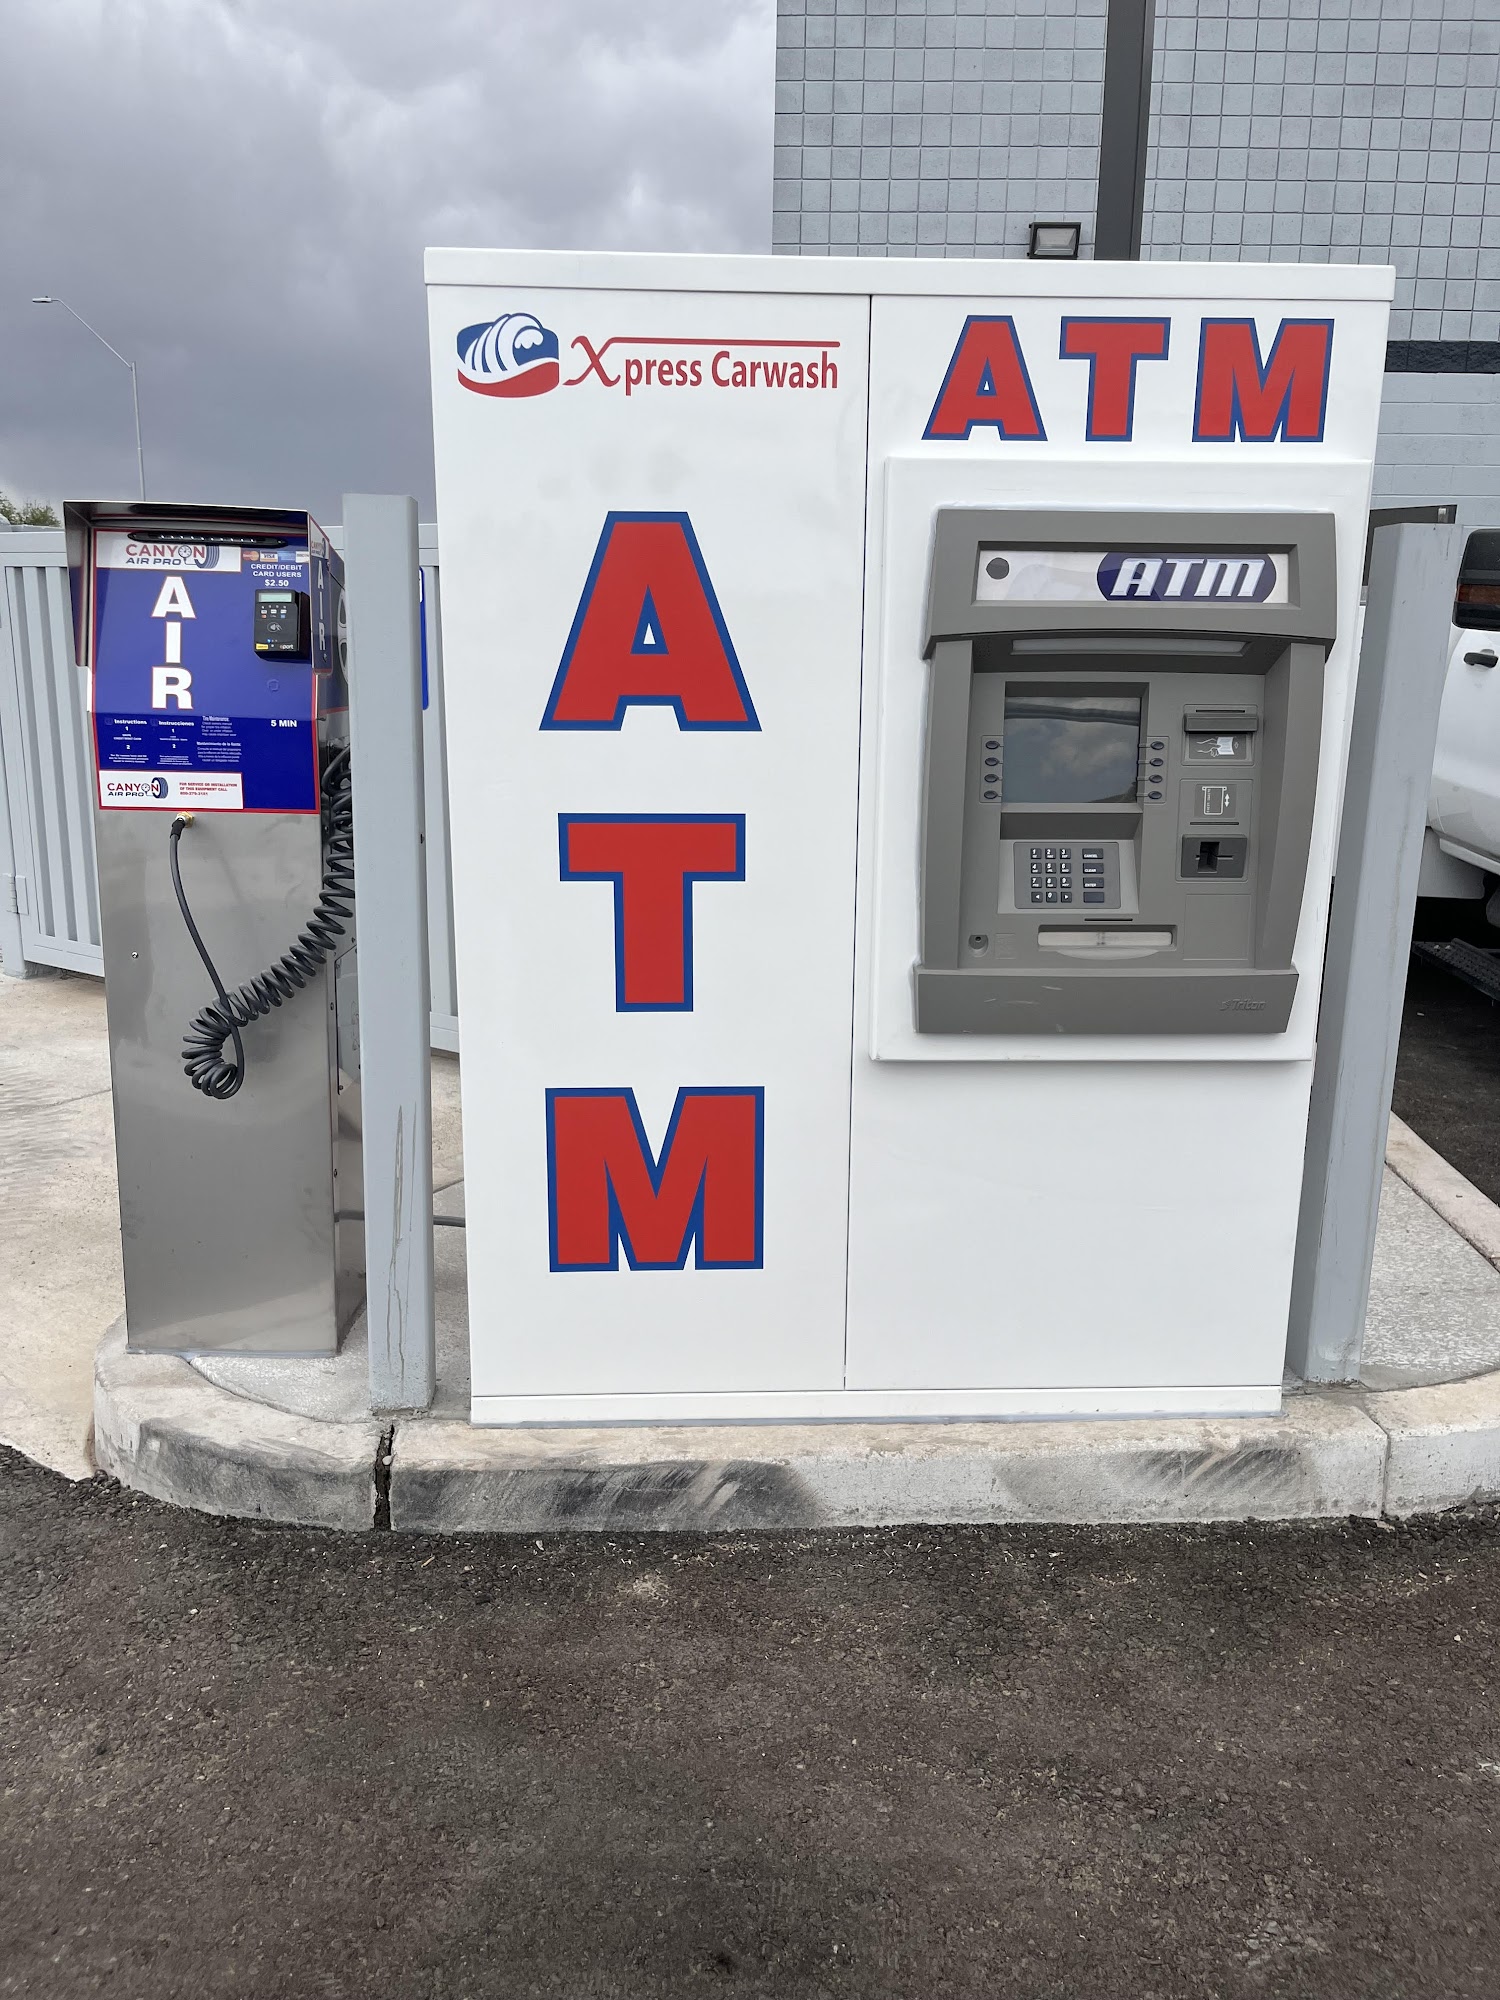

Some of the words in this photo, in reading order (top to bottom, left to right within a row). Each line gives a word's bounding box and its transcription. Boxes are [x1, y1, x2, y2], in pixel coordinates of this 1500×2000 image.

[562, 335, 702, 396] Xpress
[711, 350, 839, 390] Carwash
[921, 315, 1335, 442] ATM
[125, 543, 205, 558] CANYON
[126, 557, 150, 565] AIR
[153, 558, 181, 566] PRO
[250, 563, 303, 571] CREDIT/DEBIT
[1109, 557, 1266, 597] ATM
[264, 579, 289, 587] $2.50
[317, 559, 326, 651] AIR
[151, 576, 197, 710] AIR
[270, 719, 277, 727] 5
[278, 719, 298, 728] MIN
[107, 782, 159, 792] CANYON
[539, 511, 766, 1273] ATM
